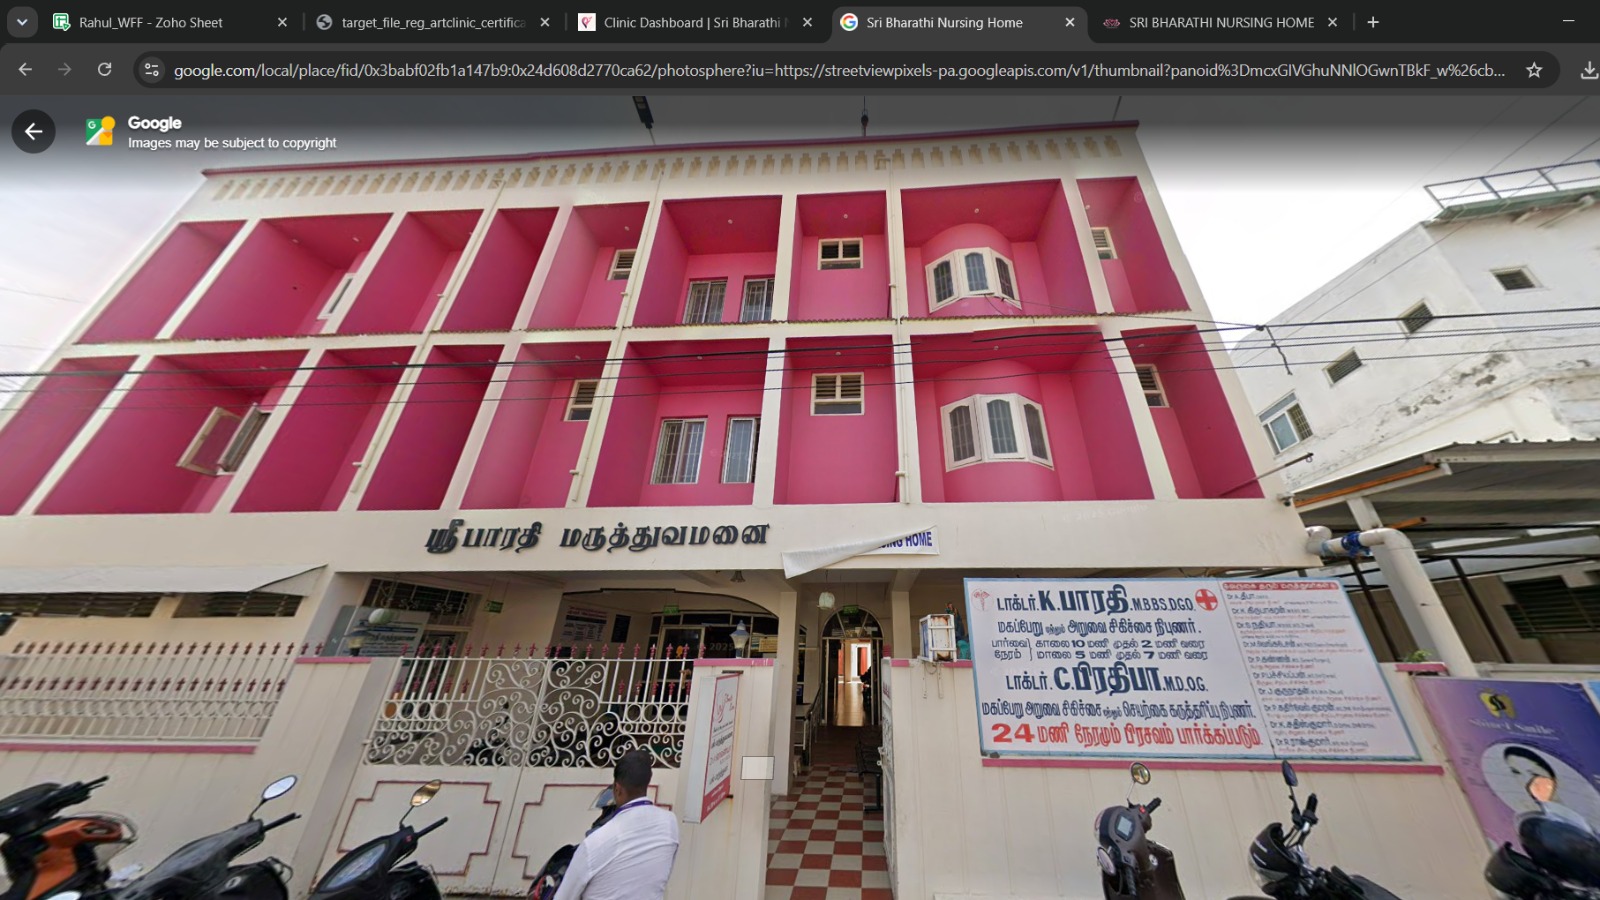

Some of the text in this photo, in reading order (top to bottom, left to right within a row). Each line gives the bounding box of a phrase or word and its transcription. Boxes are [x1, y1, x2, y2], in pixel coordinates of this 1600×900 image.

[80, 16, 144, 30] Rahul_WFF
[156, 16, 187, 29] Zoho
[190, 16, 224, 29] Sheet
[604, 16, 637, 29] Clinic
[640, 16, 704, 29] Dashboard
[714, 16, 729, 29] Sri
[733, 16, 781, 29] Bharathi
[867, 16, 1024, 31] Sri Bharathi Nursing Home
[1130, 16, 1315, 29] SRI BHARATHI NURSING HOME
[559, 521, 770, 554] மருத்துவமனை
[905, 531, 933, 547] HOME
[998, 618, 1043, 637] மகப்பேறு
[1068, 619, 1107, 637] அறுவை
[1109, 618, 1152, 634] சிகிச்சை
[1036, 639, 1069, 648] காலை
[1071, 639, 1085, 648] 10
[1087, 638, 1109, 648] மணி
[1112, 637, 1139, 650] முதல்
[1141, 640, 1153, 648] 2
[1155, 638, 1178, 648] மணி
[1180, 640, 1206, 649] வரை
[994, 648, 1208, 661] நேரம் மாலை 5 மணி முதல் 7 மணி வரை
[982, 698, 1024, 719] மகப்பேறு
[1025, 701, 1060, 719] அறுவை
[1062, 699, 1102, 717] சிகிச்சை
[1122, 700, 1169, 720] செயற்கை
[992, 723, 1035, 743] 24
[1037, 722, 1069, 743] மணி
[1074, 722, 1121, 748] நேரமும்
[1123, 722, 1174, 747] பிரசவம்
